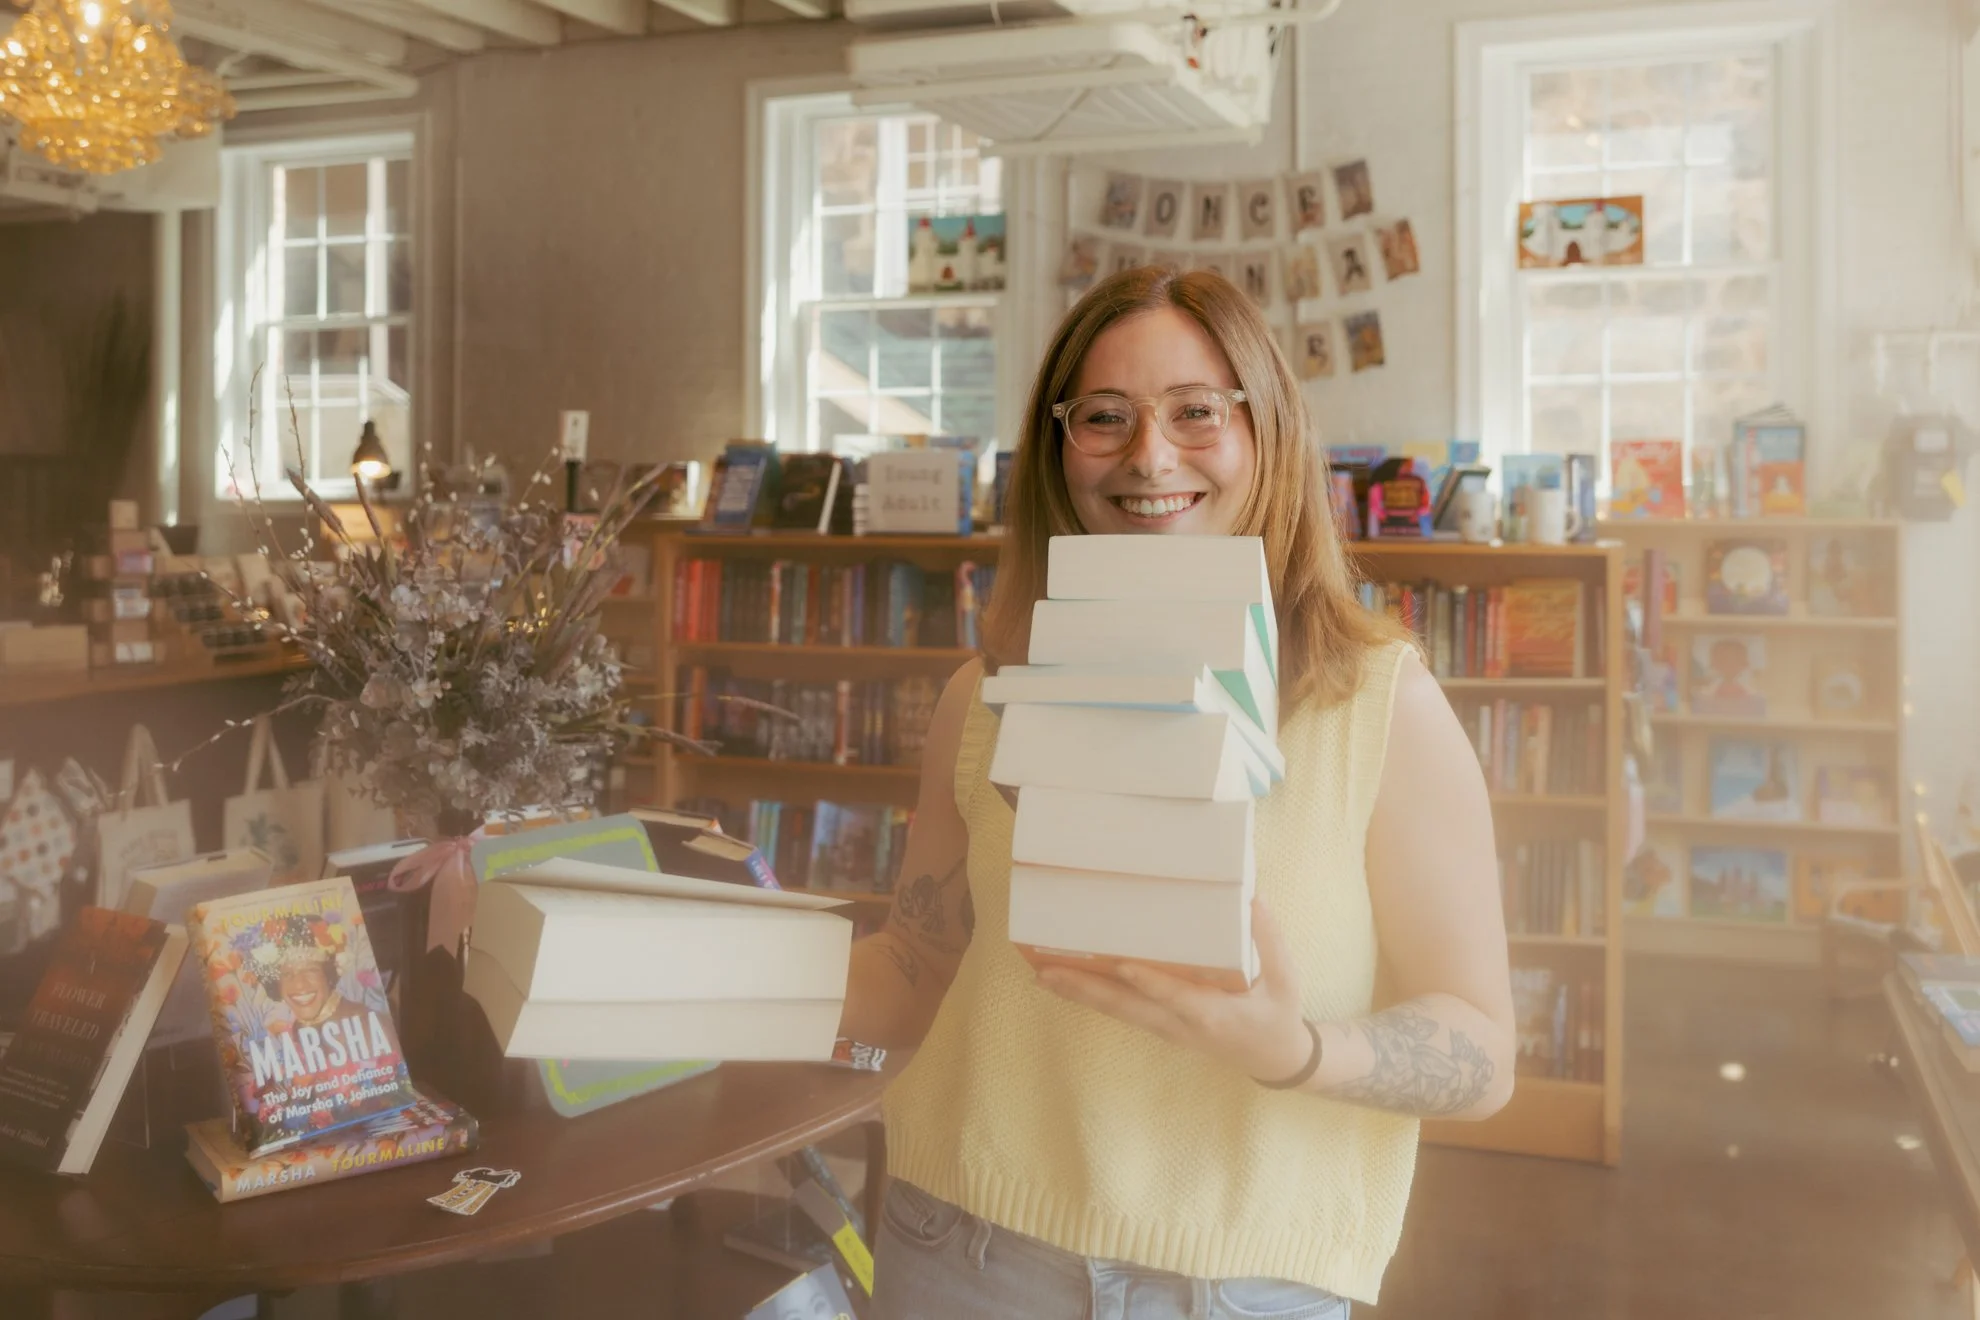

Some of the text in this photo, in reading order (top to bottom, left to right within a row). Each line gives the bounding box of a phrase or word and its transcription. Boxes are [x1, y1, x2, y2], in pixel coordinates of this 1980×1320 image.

[1155, 185, 1319, 229] ONCE
[1341, 247, 1366, 281] A
[53, 983, 106, 1009] FLOWER
[33, 1010, 100, 1041] TRAVELED
[249, 1011, 393, 1089] MARSHA
[262, 1064, 394, 1107] The Joy and Defiance
[268, 1080, 399, 1124] of Marsha P. Johnson
[235, 1136, 446, 1193] MARSHA TOURMALINE
